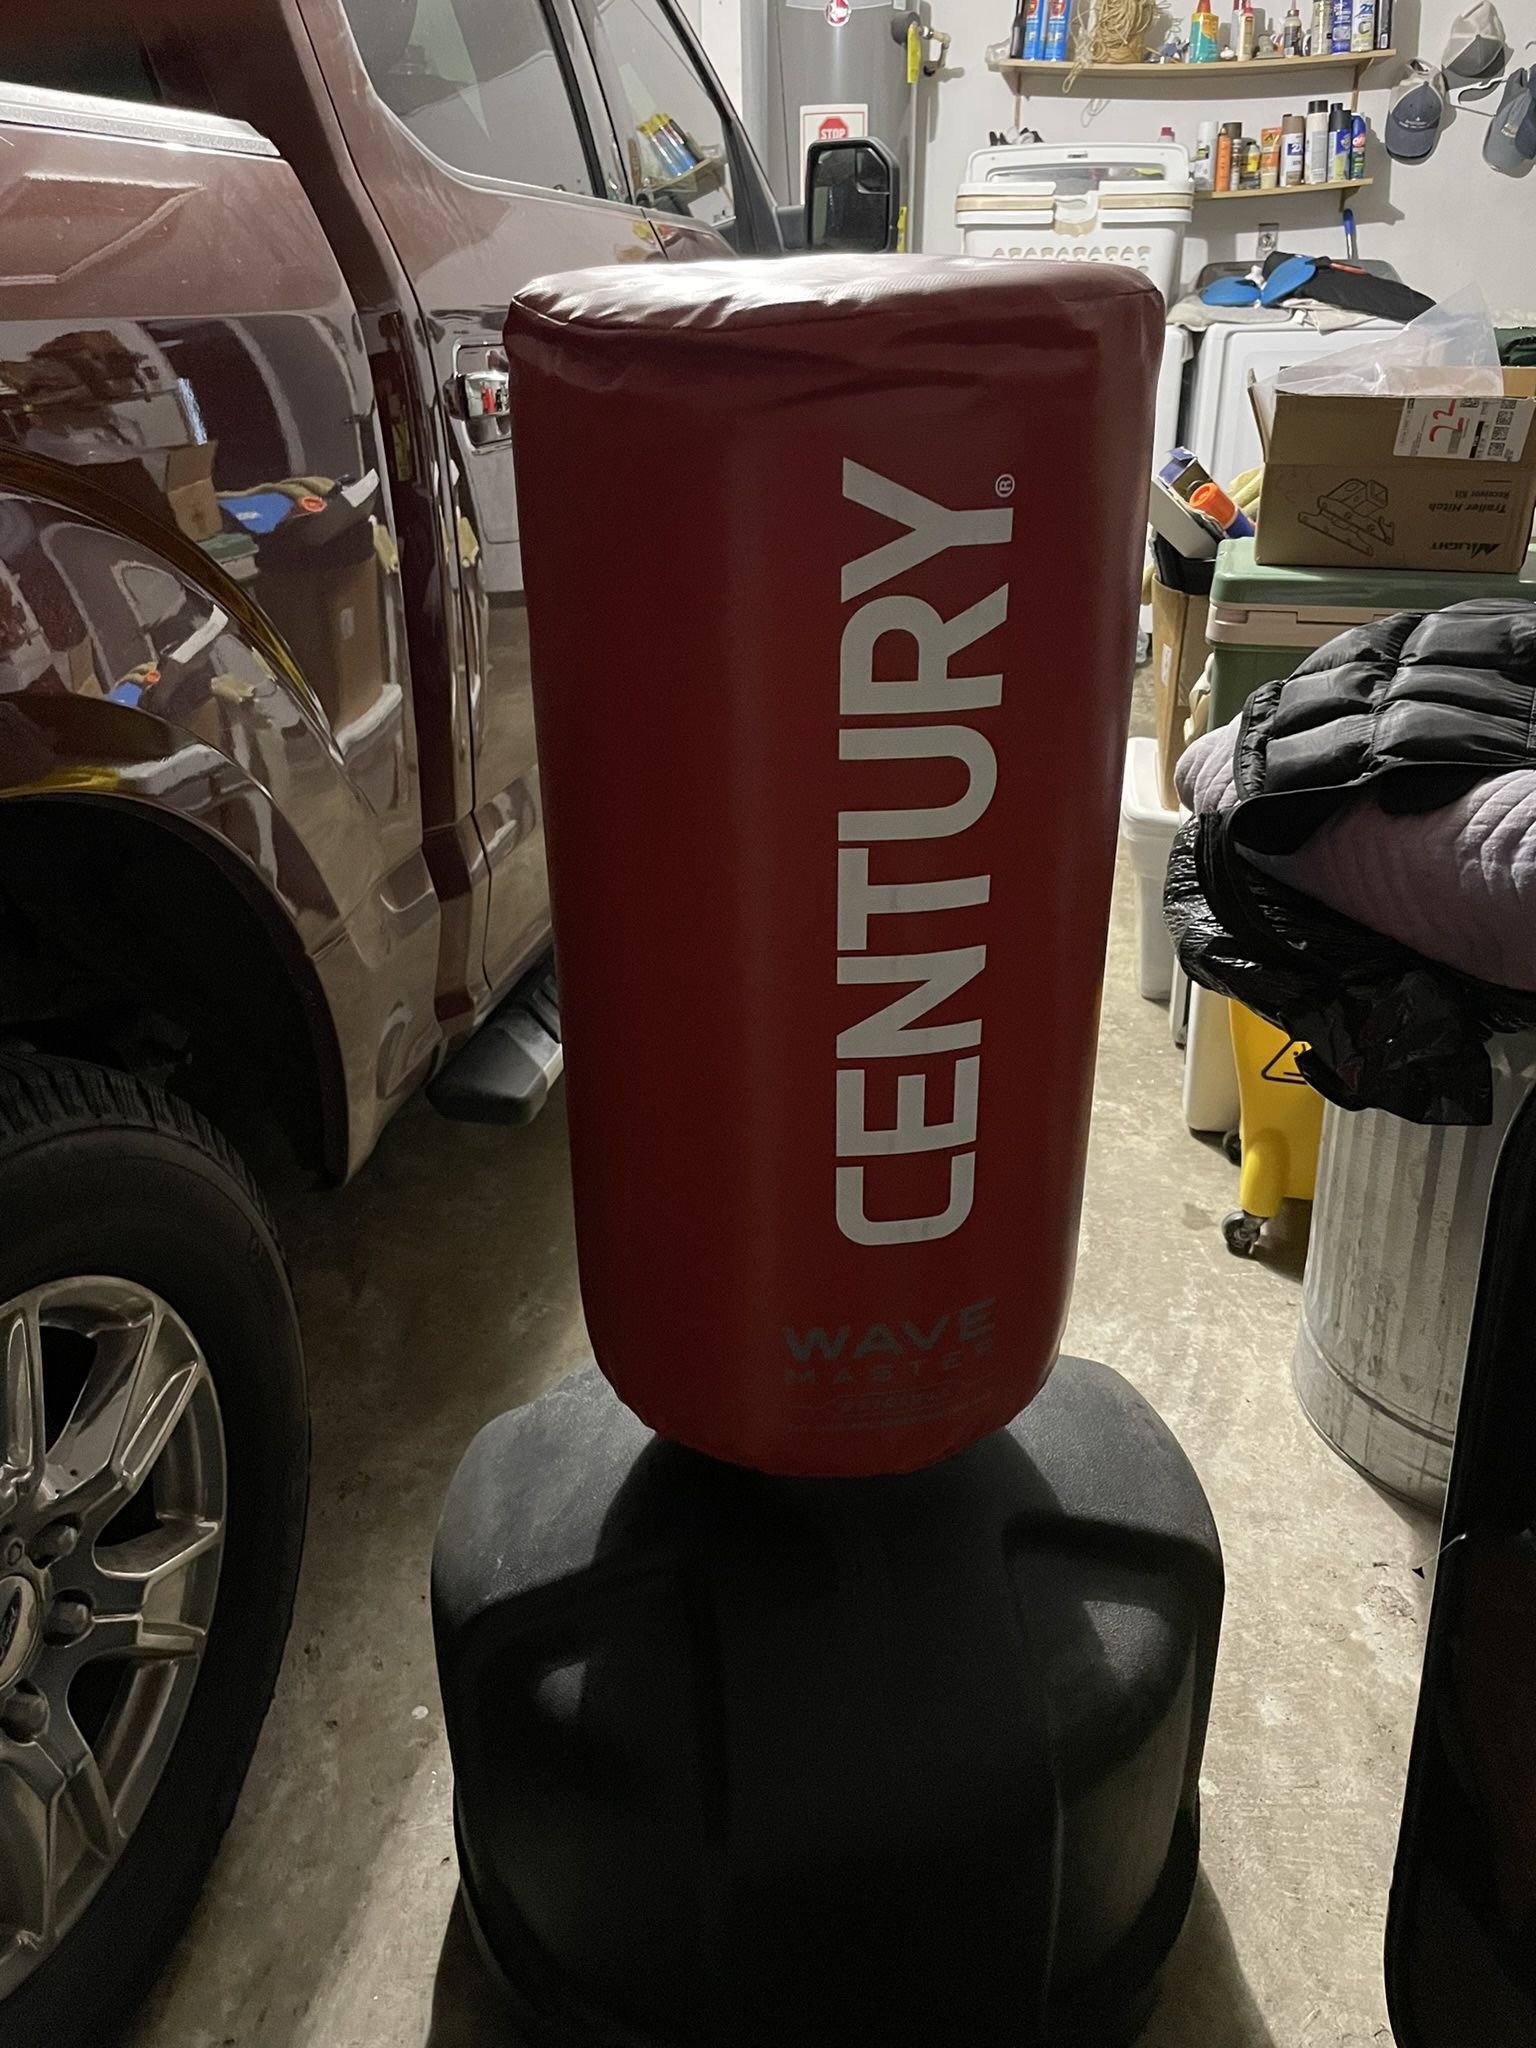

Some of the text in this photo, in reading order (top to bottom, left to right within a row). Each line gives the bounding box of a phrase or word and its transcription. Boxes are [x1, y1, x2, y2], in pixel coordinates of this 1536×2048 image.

[820, 128, 847, 139] STOP
[1428, 503, 1507, 514] Trailer Hitch
[836, 456, 1014, 1247] CENTURY
[782, 1295, 997, 1362] WAVE
